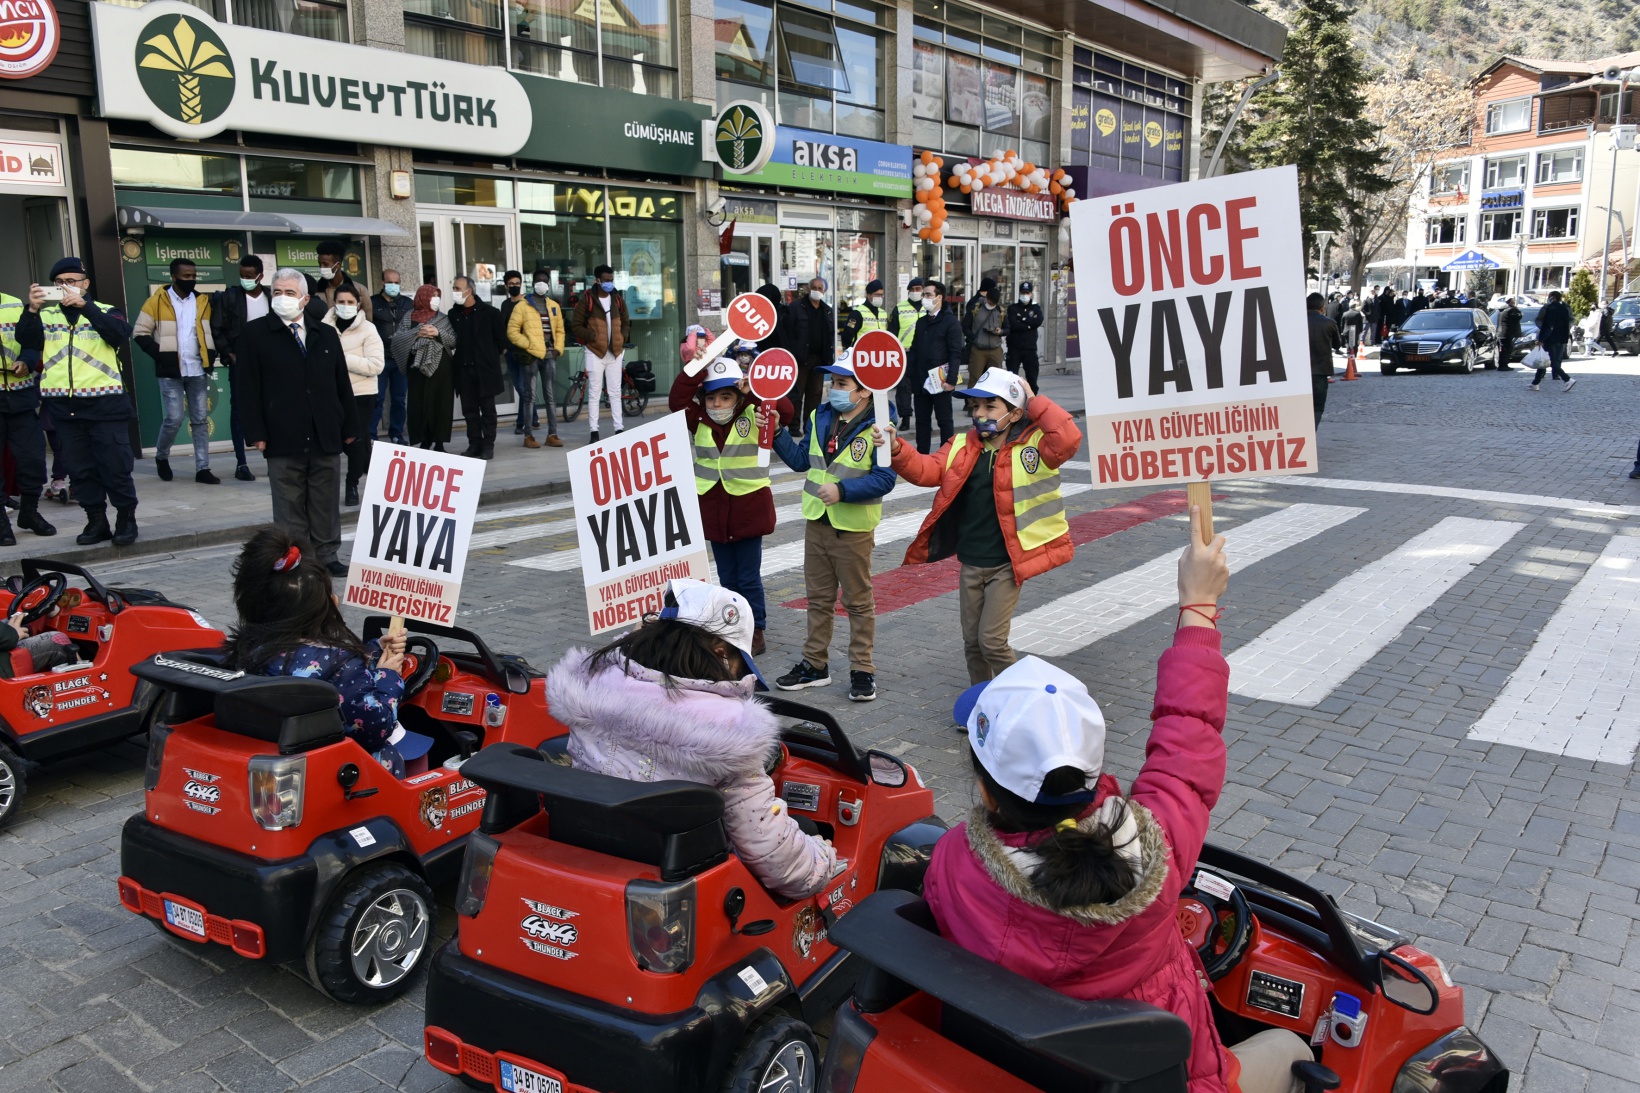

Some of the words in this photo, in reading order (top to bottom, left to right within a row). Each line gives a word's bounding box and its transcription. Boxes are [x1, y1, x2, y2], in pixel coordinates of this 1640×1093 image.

[1098, 113, 1114, 126] gratis
[624, 122, 694, 146] GÜMÜŞHANE
[1147, 125, 1161, 137] gratis
[794, 140, 857, 171] aksa
[792, 169, 859, 185] ELEKTRİK
[734, 206, 754, 215] aksa
[974, 191, 1004, 214] MEGA
[996, 225, 1010, 235] NBB
[156, 242, 211, 262] İşlematik
[287, 246, 318, 263] İşlema
[1108, 196, 1262, 296] ÖNCE
[734, 297, 770, 336] DUR
[1097, 286, 1287, 399] YAYA
[856, 350, 901, 369] DUR
[753, 365, 793, 381] DUR
[1111, 418, 1156, 445] YAYA
[1160, 403, 1280, 440] GÜVENLİĞİNİN
[589, 432, 672, 506] ÖNCE
[1097, 432, 1307, 484] NÖBETÇİSİYİZ
[384, 450, 463, 514] ÖNCE
[369, 504, 456, 574] YAYA
[587, 486, 691, 572] YAYA
[361, 568, 382, 586] YAYA
[384, 572, 443, 599] GÜVENLİĞİNİN
[599, 581, 623, 603] YAYA
[625, 560, 690, 595] GÜVENLİĞİNİN
[347, 585, 452, 624] NÖBETÇİSİYİZ
[54, 675, 92, 692] BLACK
[56, 695, 98, 711] THUNDER
[449, 779, 478, 795] BLAC
[537, 903, 562, 917] BLACK
[533, 942, 564, 958] THUNDER
[503, 1077, 512, 1088] TR
[514, 1068, 523, 1086] 34
[525, 1072, 534, 1090] BT
